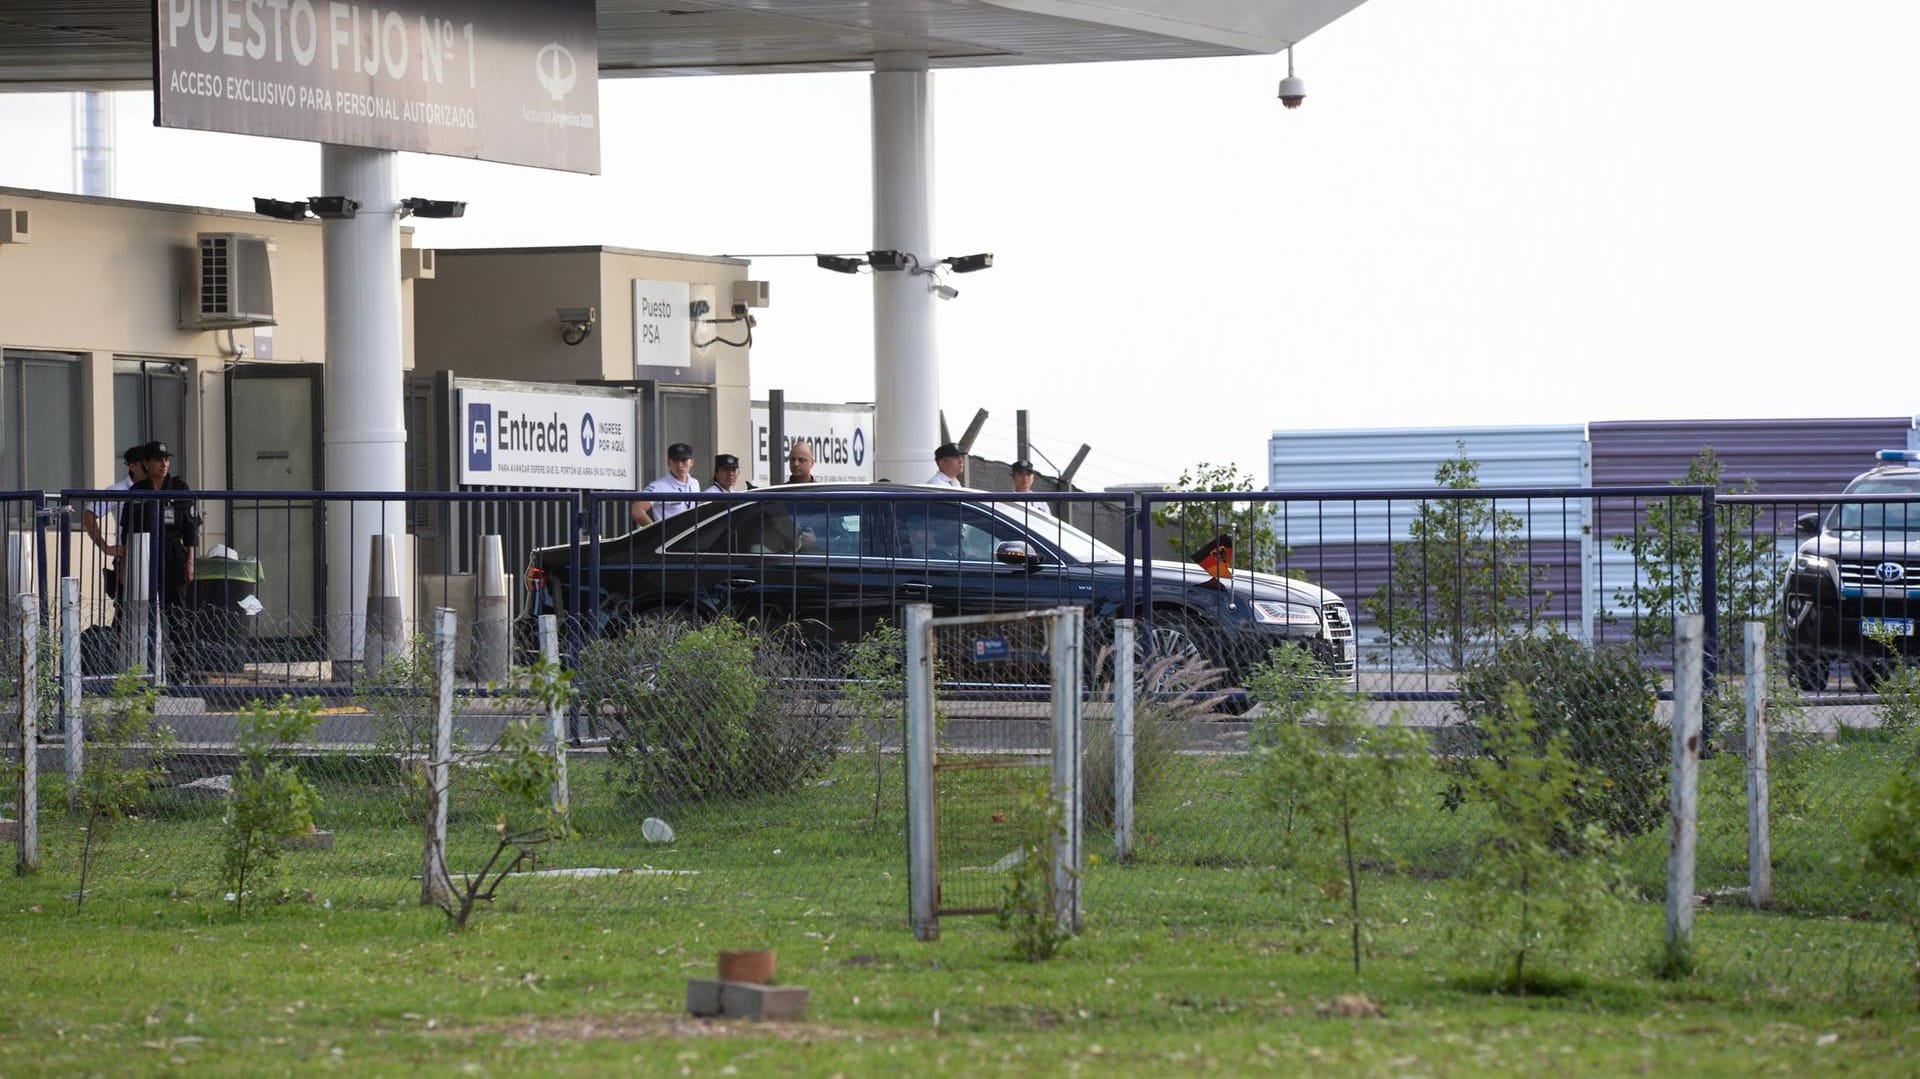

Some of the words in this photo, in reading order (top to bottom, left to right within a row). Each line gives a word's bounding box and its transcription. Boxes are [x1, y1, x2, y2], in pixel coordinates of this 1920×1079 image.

[169, 0, 317, 66] PUESTO
[329, 2, 408, 79] FIJO
[463, 22, 476, 89] 1
[170, 69, 222, 98] ACCESO
[227, 77, 295, 107] EXCLUSIVO
[300, 87, 333, 112] PARA
[336, 91, 400, 120] PERSONAL
[403, 99, 478, 128] AUTORIZADO.
[642, 297, 672, 318] Puesto
[642, 324, 661, 344] PSA
[498, 410, 569, 453] Entrada
[598, 422, 622, 435] INGRESE
[598, 439, 610, 451] POR
